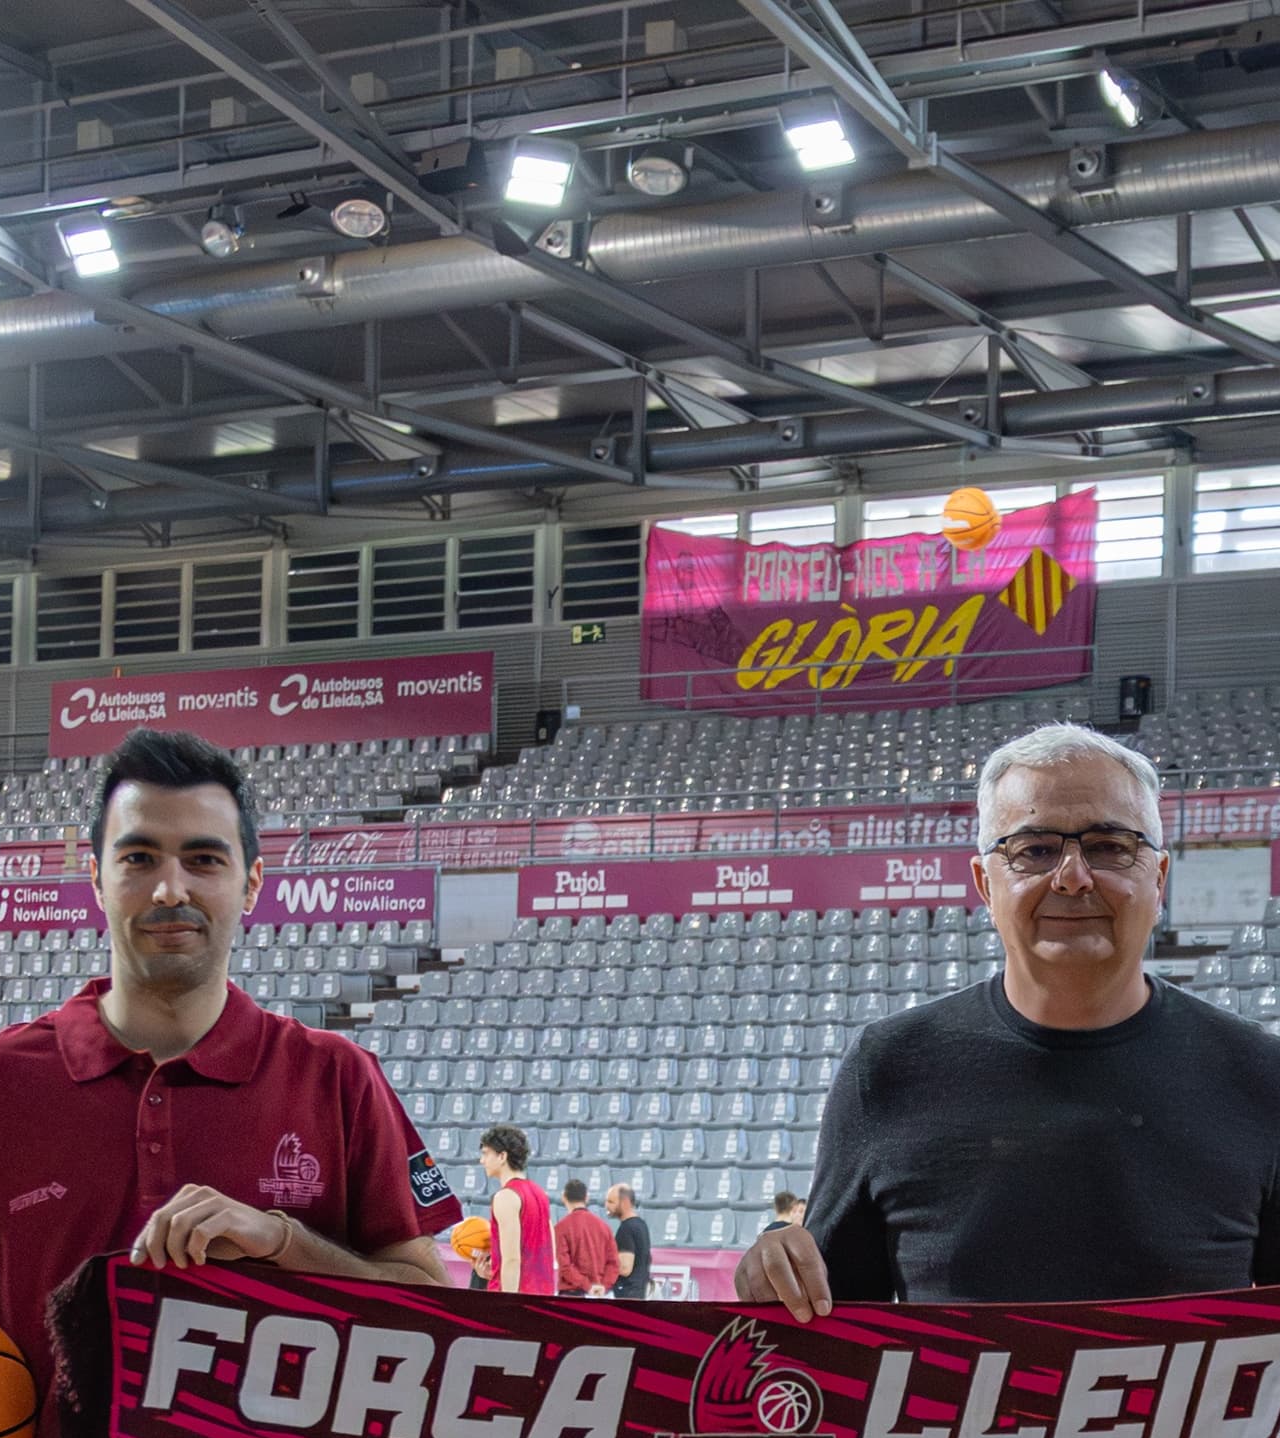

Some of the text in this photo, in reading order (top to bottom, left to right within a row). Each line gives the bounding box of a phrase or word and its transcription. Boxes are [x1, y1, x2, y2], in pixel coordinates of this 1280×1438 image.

[311, 677, 383, 693] Autobusos
[397, 671, 483, 697] moventis
[99, 691, 166, 707] Autobusos
[178, 686, 258, 711] moventis
[302, 695, 319, 710] de
[90, 709, 106, 723] de
[715, 864, 770, 893] Pujol
[885, 858, 943, 886] Pujol
[344, 876, 395, 892] Clínica
[555, 869, 606, 896] Pujol
[343, 896, 426, 912] NovAliança
[13, 908, 88, 923] NovAliança
